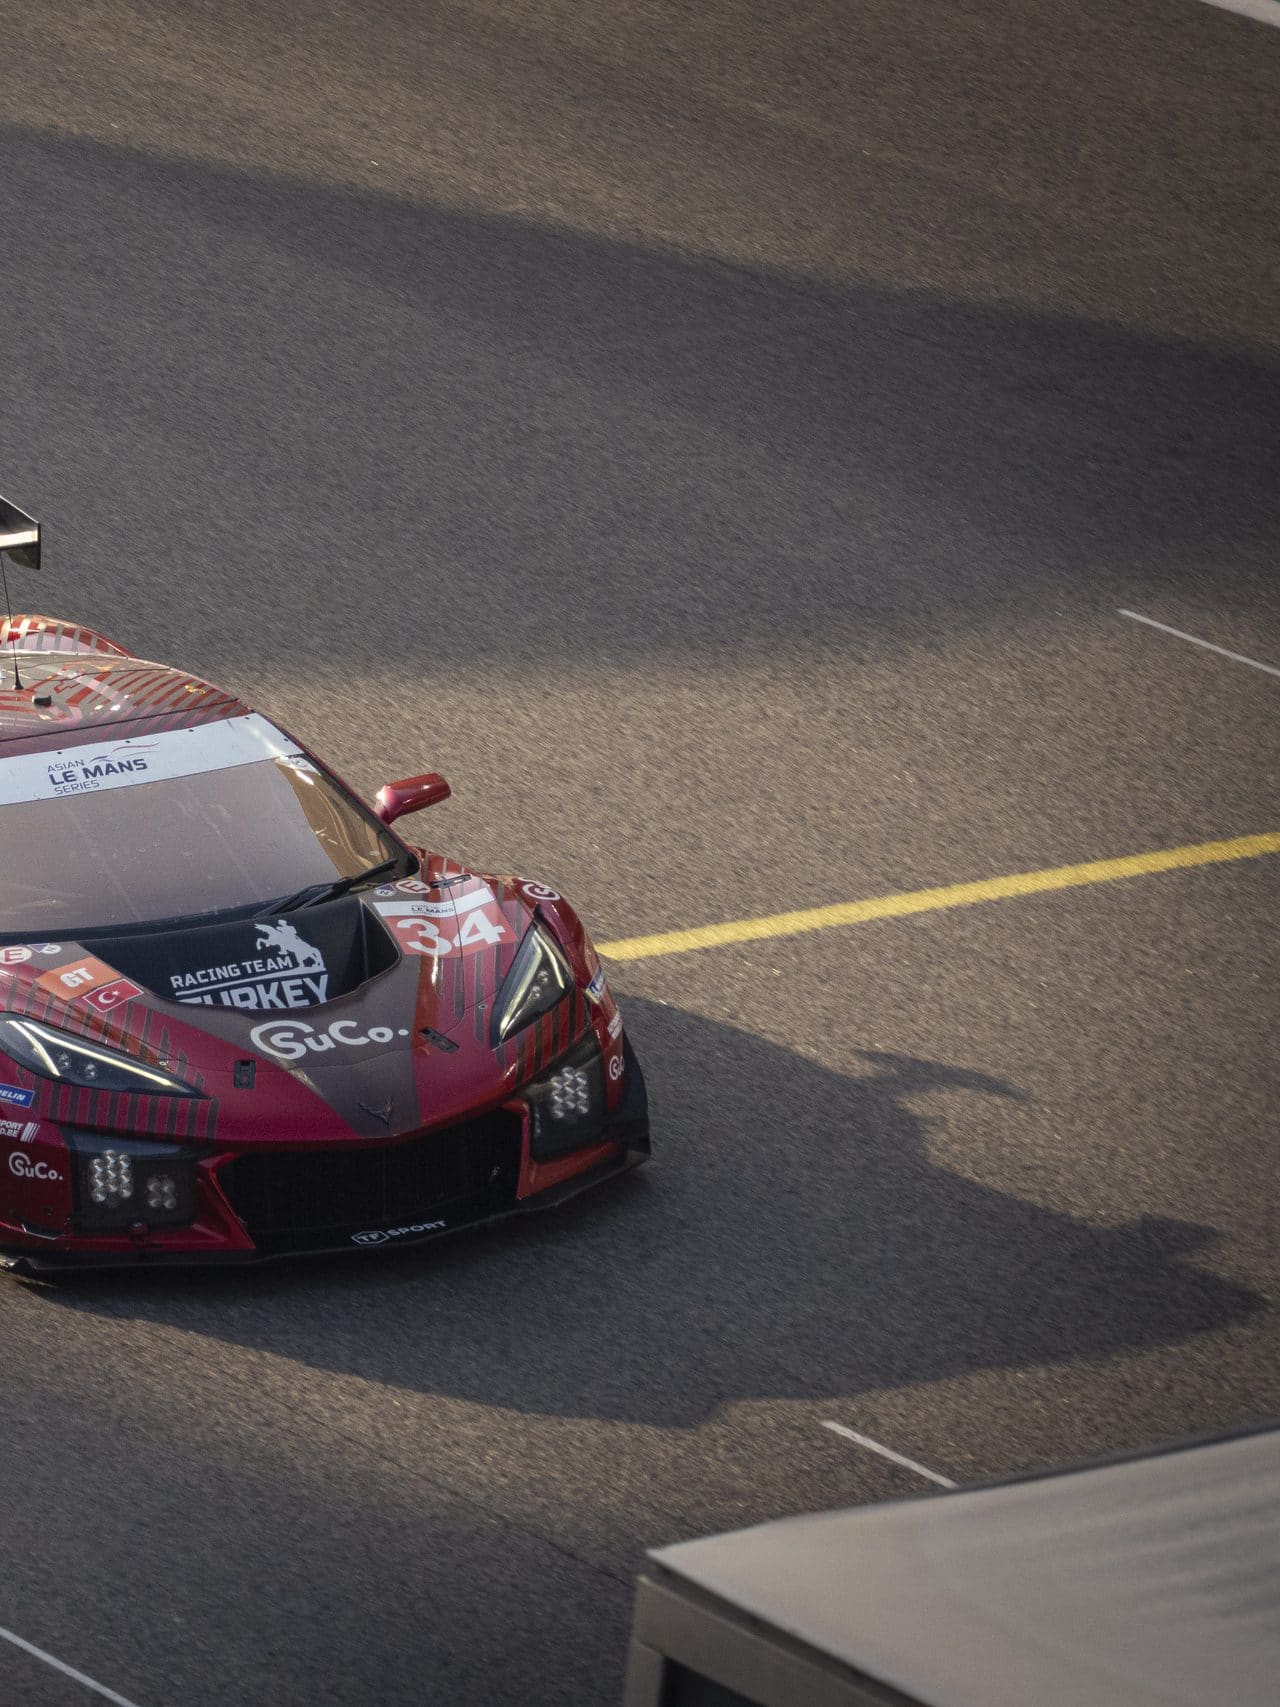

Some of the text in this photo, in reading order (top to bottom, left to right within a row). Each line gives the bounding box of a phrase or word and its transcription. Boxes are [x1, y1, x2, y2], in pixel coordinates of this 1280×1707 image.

[47, 759, 85, 773] ASIAN
[49, 758, 148, 785] LE MANS
[54, 780, 100, 795] SERIES
[397, 910, 506, 956] 34
[60, 967, 95, 988] GT
[170, 955, 293, 989] RACING TEAM
[178, 974, 328, 1010] RKEY
[387, 1220, 446, 1236] SPORT
